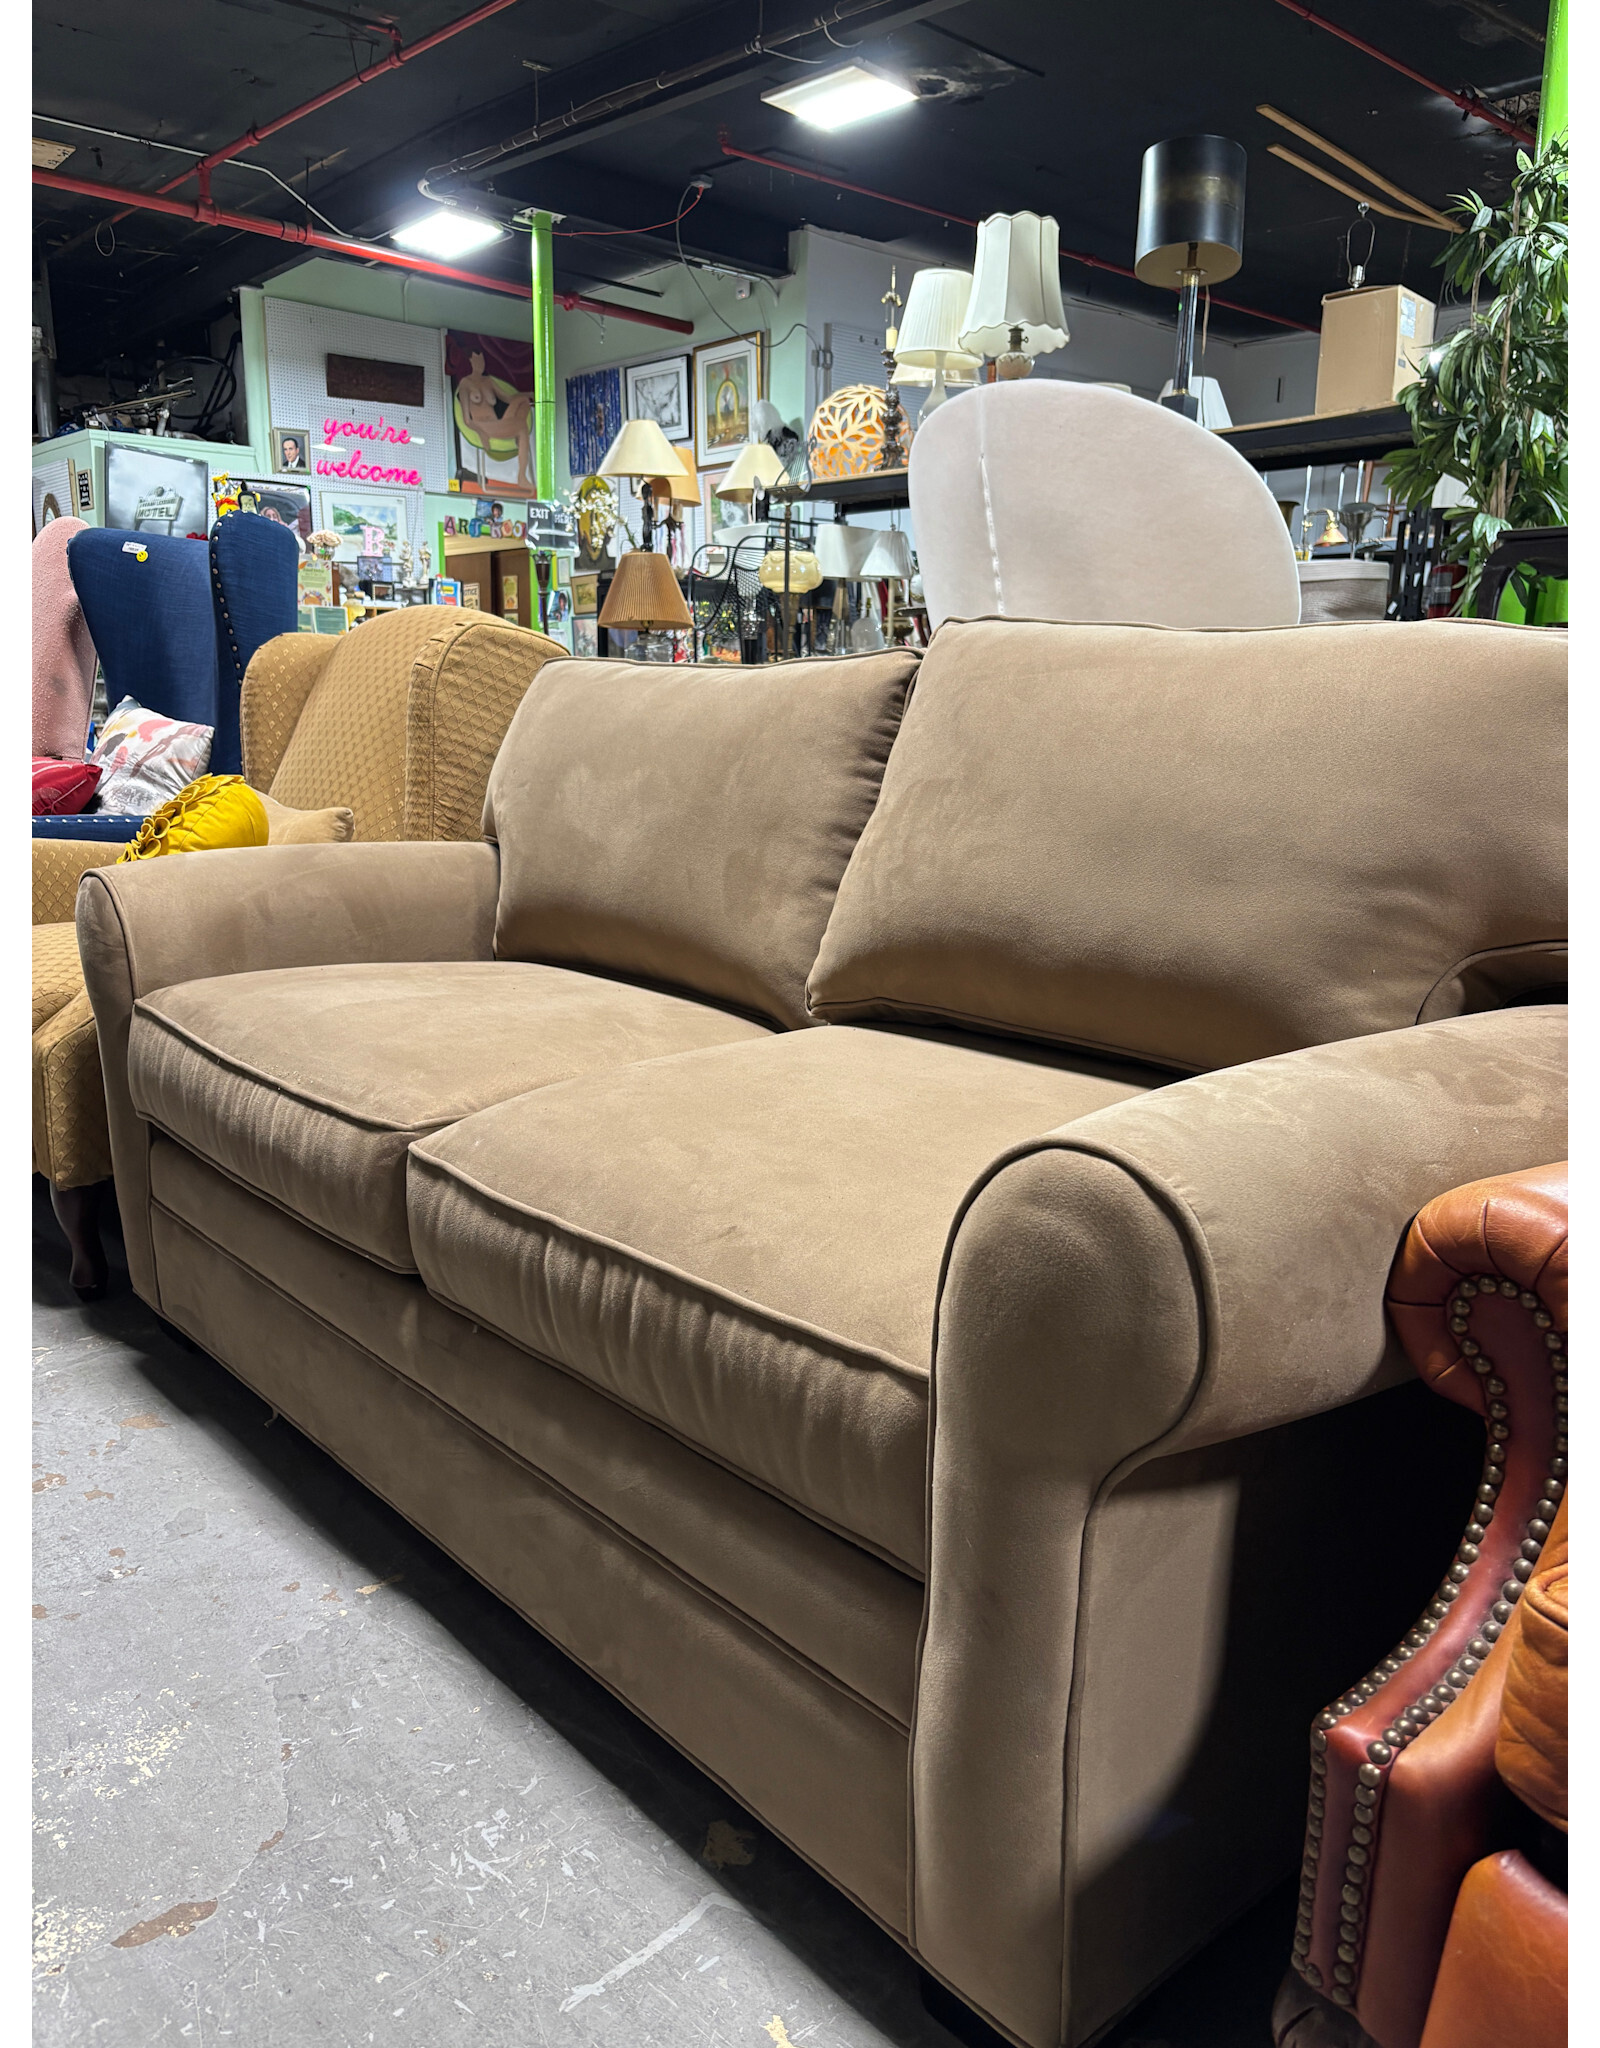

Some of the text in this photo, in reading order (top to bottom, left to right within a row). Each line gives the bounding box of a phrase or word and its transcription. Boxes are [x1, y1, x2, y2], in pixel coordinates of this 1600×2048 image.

[323, 416, 411, 445] you're
[316, 450, 422, 486] welcome
[137, 506, 174, 518] MOTEL
[530, 507, 573, 524] EXIT HERE
[444, 516, 481, 538] ART
[359, 525, 385, 557] B
